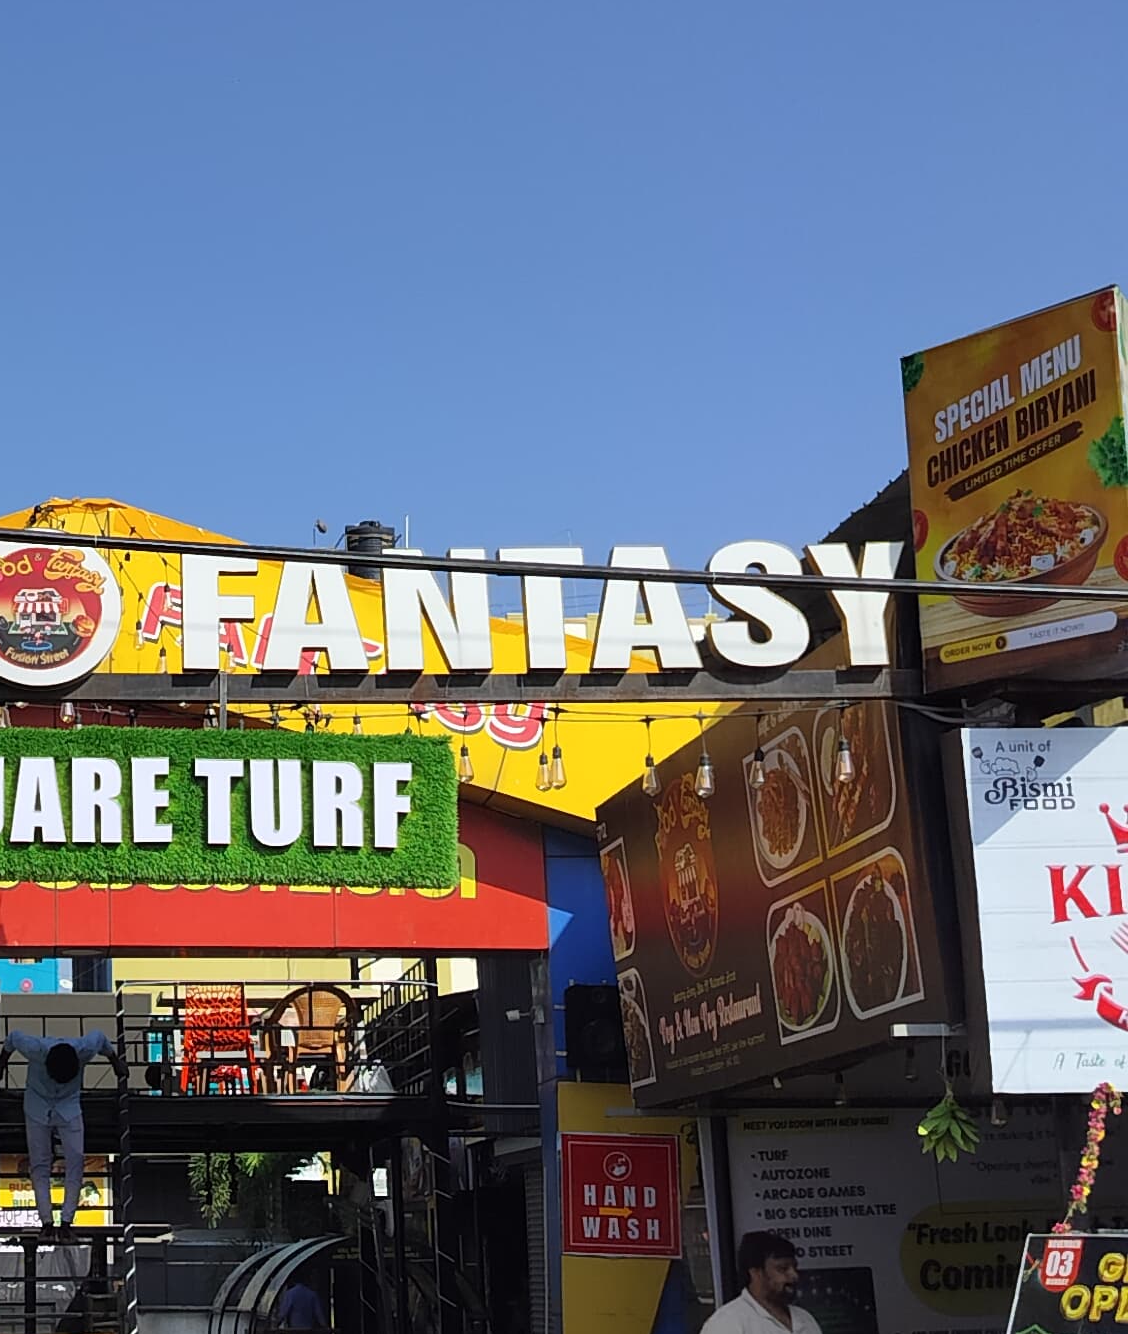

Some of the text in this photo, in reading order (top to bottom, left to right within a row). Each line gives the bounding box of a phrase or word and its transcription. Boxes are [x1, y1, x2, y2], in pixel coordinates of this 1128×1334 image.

[934, 333, 1082, 444] SPECIAL MENU
[927, 368, 1097, 488] CHICKEN BIRYANI
[963, 433, 1062, 492] LIMITED TIME OFFER
[43, 547, 107, 595] Fantasy
[182, 538, 905, 672] FANTASY
[4, 647, 70, 665] Fusion Street
[943, 640, 992, 659] ORDER NOW
[995, 740, 1051, 753] A unit of
[984, 776, 1074, 805] Bismi
[194, 758, 413, 849] TURF
[1010, 798, 1076, 811] FOOD
[1075, 1051, 1106, 1069] Taste
[758, 1150, 788, 1161] TURF
[760, 1168, 830, 1181] AUTOZONE
[583, 1185, 658, 1208] HAND
[763, 1185, 866, 1200] ARCADE GAMES
[765, 1203, 897, 1220] BIG SCREEN THEATRE
[582, 1219, 661, 1241] WASH
[804, 1226, 832, 1237] DINE
[809, 1245, 853, 1257] STREET
[1045, 1250, 1074, 1277] 03
